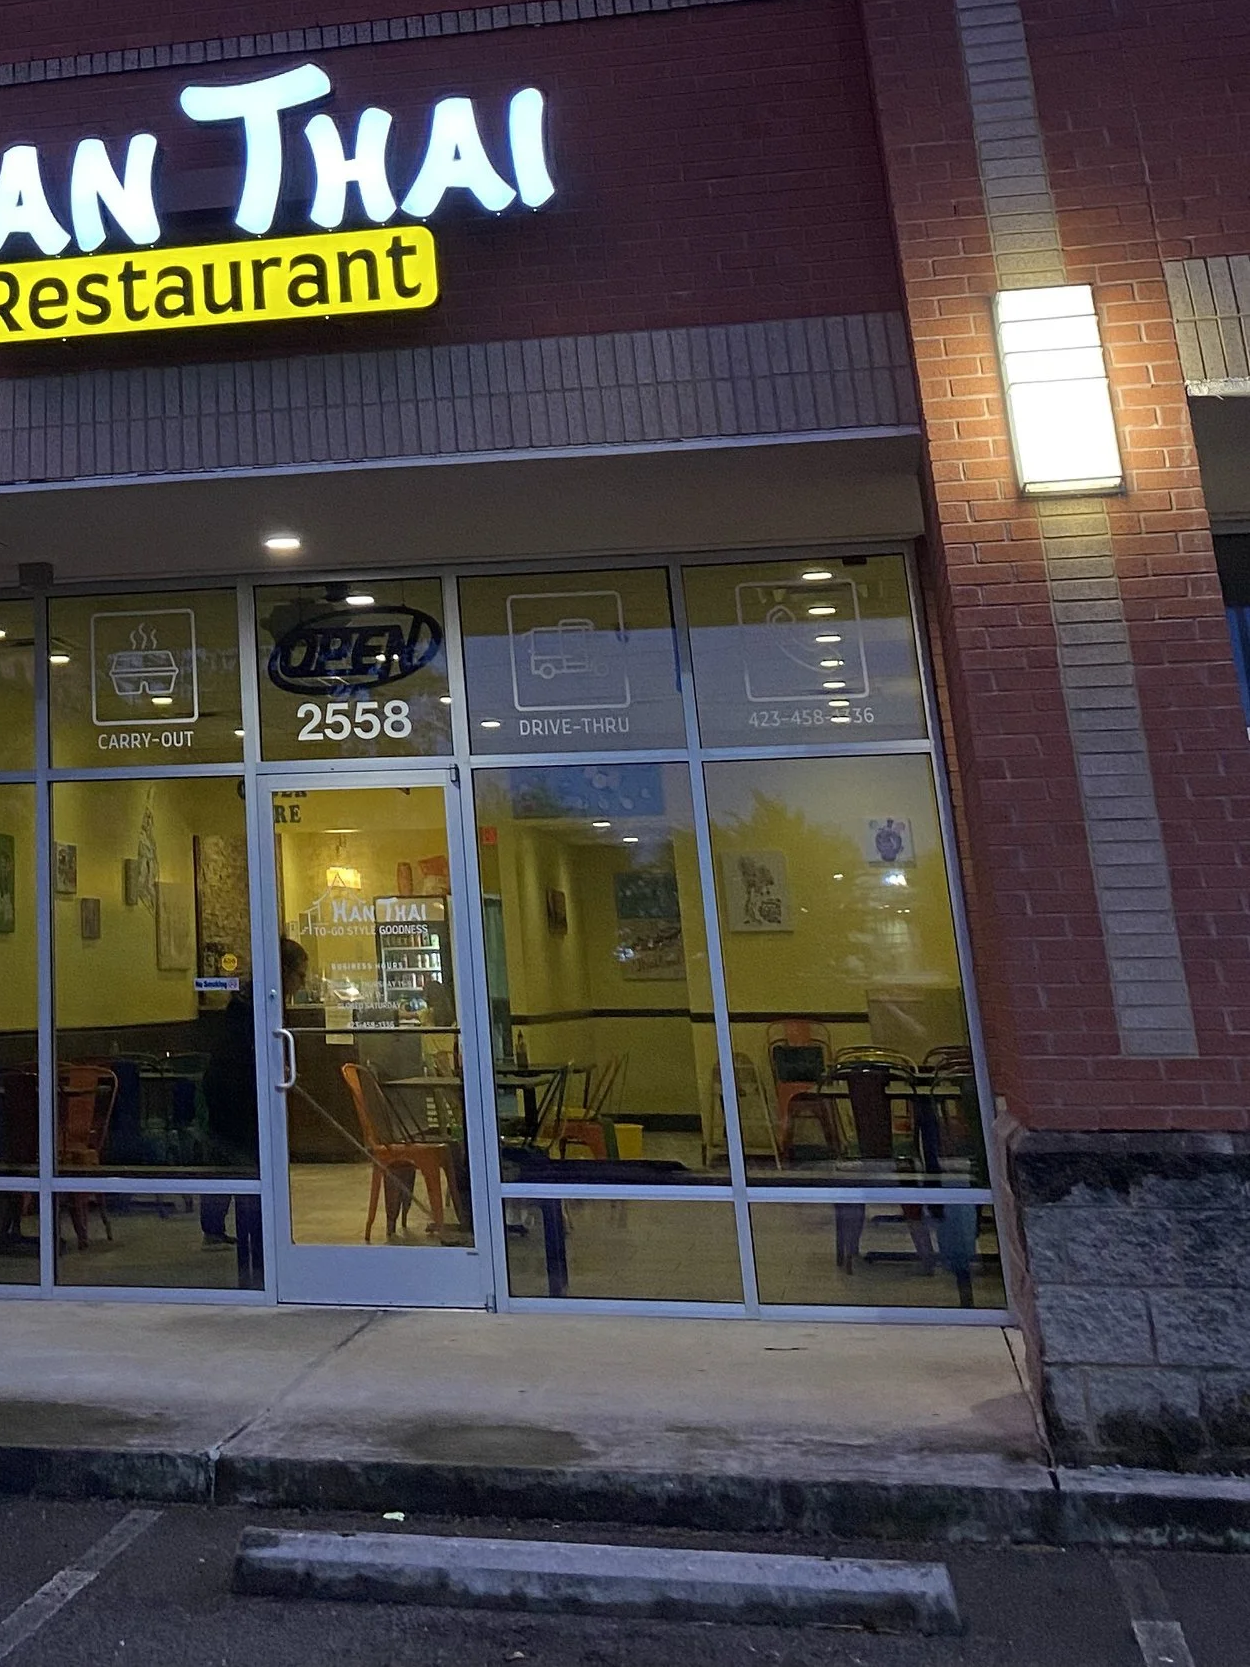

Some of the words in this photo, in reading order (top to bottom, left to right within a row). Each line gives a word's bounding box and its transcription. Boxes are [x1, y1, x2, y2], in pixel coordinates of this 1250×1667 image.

[180, 63, 556, 234] THAI
[280, 616, 422, 680] OPEN
[297, 700, 412, 741] 2558
[519, 717, 629, 735] DRIVE-THRU
[98, 730, 194, 749] CARRY-OUT
[332, 899, 375, 923] HAN
[376, 897, 427, 922] THAI
[314, 926, 344, 936] TO-GO
[346, 925, 376, 935] STYLE
[379, 924, 428, 935] GOODNESS
[375, 961, 403, 970] HOURS
